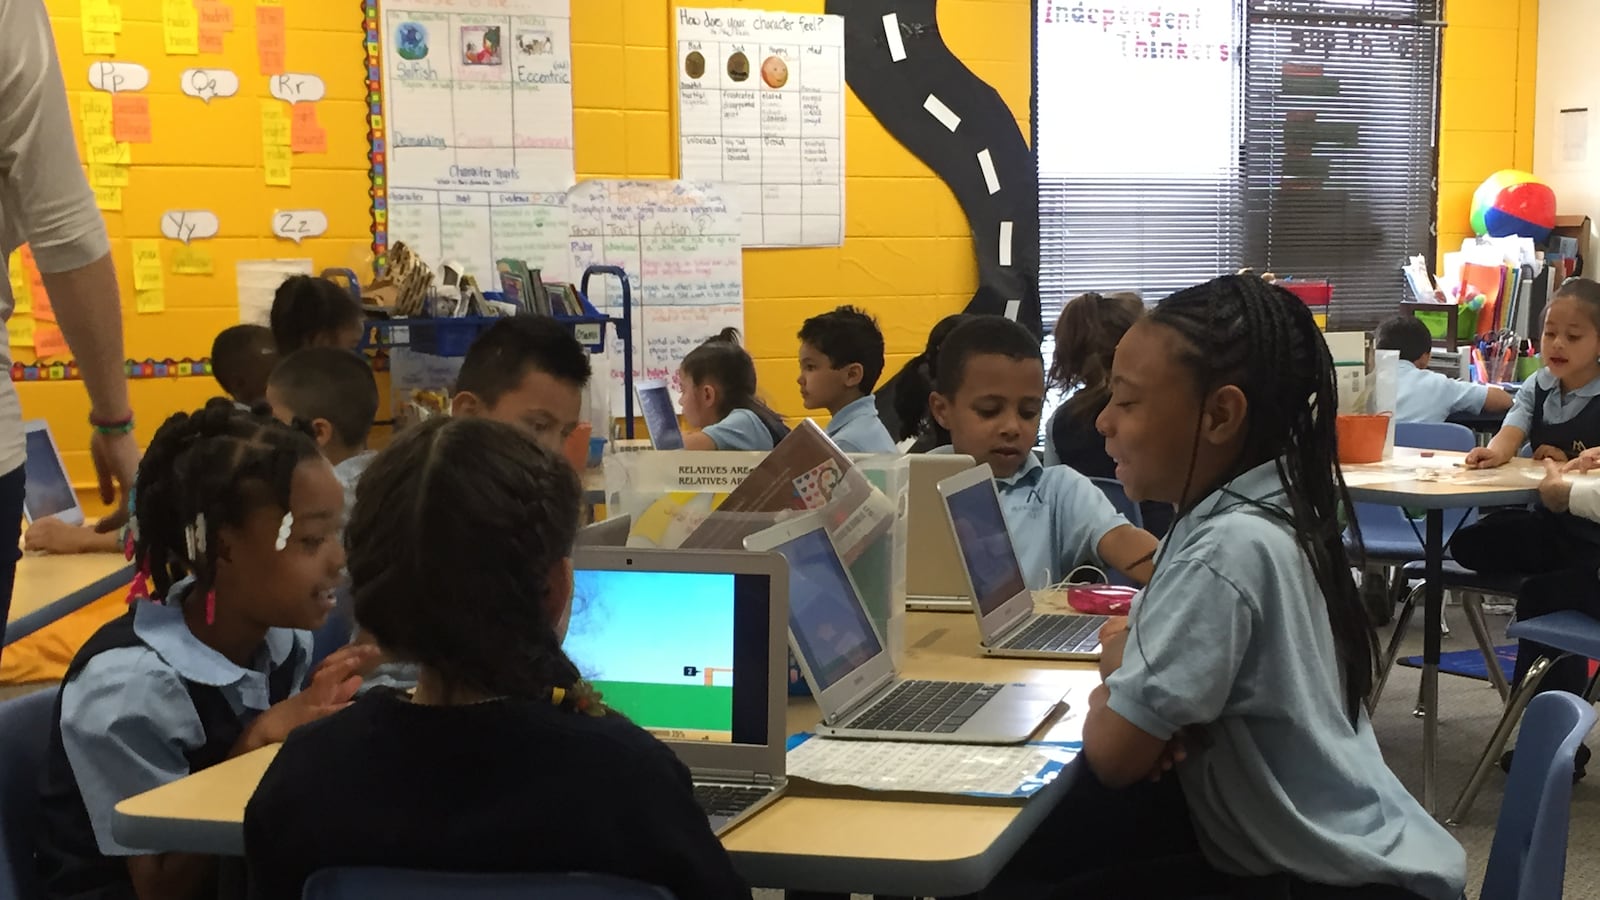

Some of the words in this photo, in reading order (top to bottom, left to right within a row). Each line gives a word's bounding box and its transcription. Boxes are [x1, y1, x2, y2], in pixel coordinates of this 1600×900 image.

[680, 9, 701, 26] How
[703, 11, 723, 28] does
[727, 17, 747, 30] your
[752, 17, 796, 32] character
[798, 16, 825, 33] feel?
[768, 45, 789, 57] Happy
[806, 45, 823, 56] Mad
[1116, 30, 1230, 62] Thinkers
[99, 62, 125, 92] Pp
[397, 59, 438, 81] Selfish
[518, 66, 570, 84] Eccentric
[191, 70, 218, 95] Qq
[277, 74, 306, 95] Rr
[393, 131, 448, 149] Demanding
[449, 165, 491, 178] Character
[495, 167, 520, 180] Traits
[167, 212, 197, 241] Yy
[279, 214, 311, 234] Zz
[606, 222, 636, 236] Trait
[653, 222, 691, 236] Action
[678, 466, 728, 474] RELATIVES
[730, 466, 750, 475] ARE
[678, 477, 728, 486] RELATIVES
